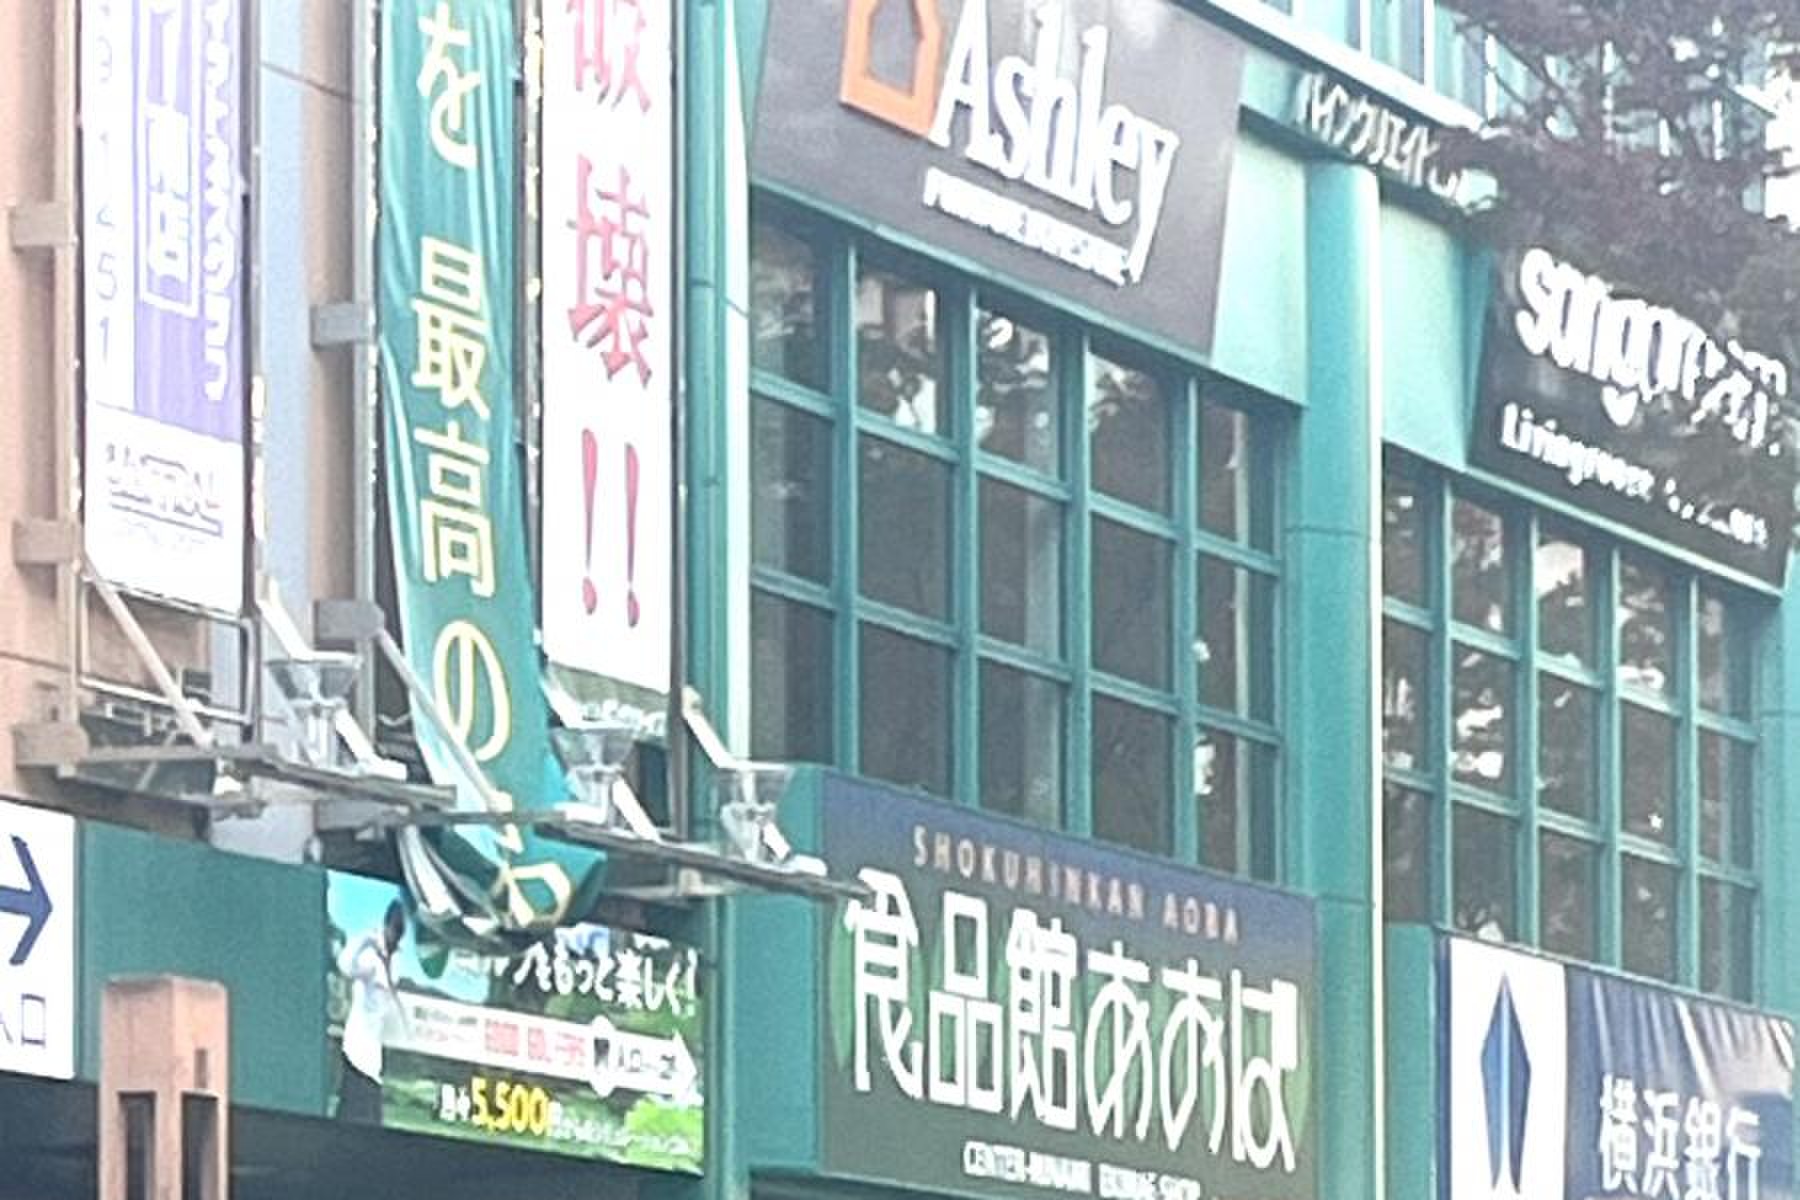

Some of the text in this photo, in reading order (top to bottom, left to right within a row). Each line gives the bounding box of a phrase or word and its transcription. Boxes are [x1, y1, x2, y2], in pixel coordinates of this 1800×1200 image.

[926, 0, 1181, 286] Ashley
[844, 867, 1298, 1173] 食品館あおば
[1163, 892, 1238, 947] AOBA
